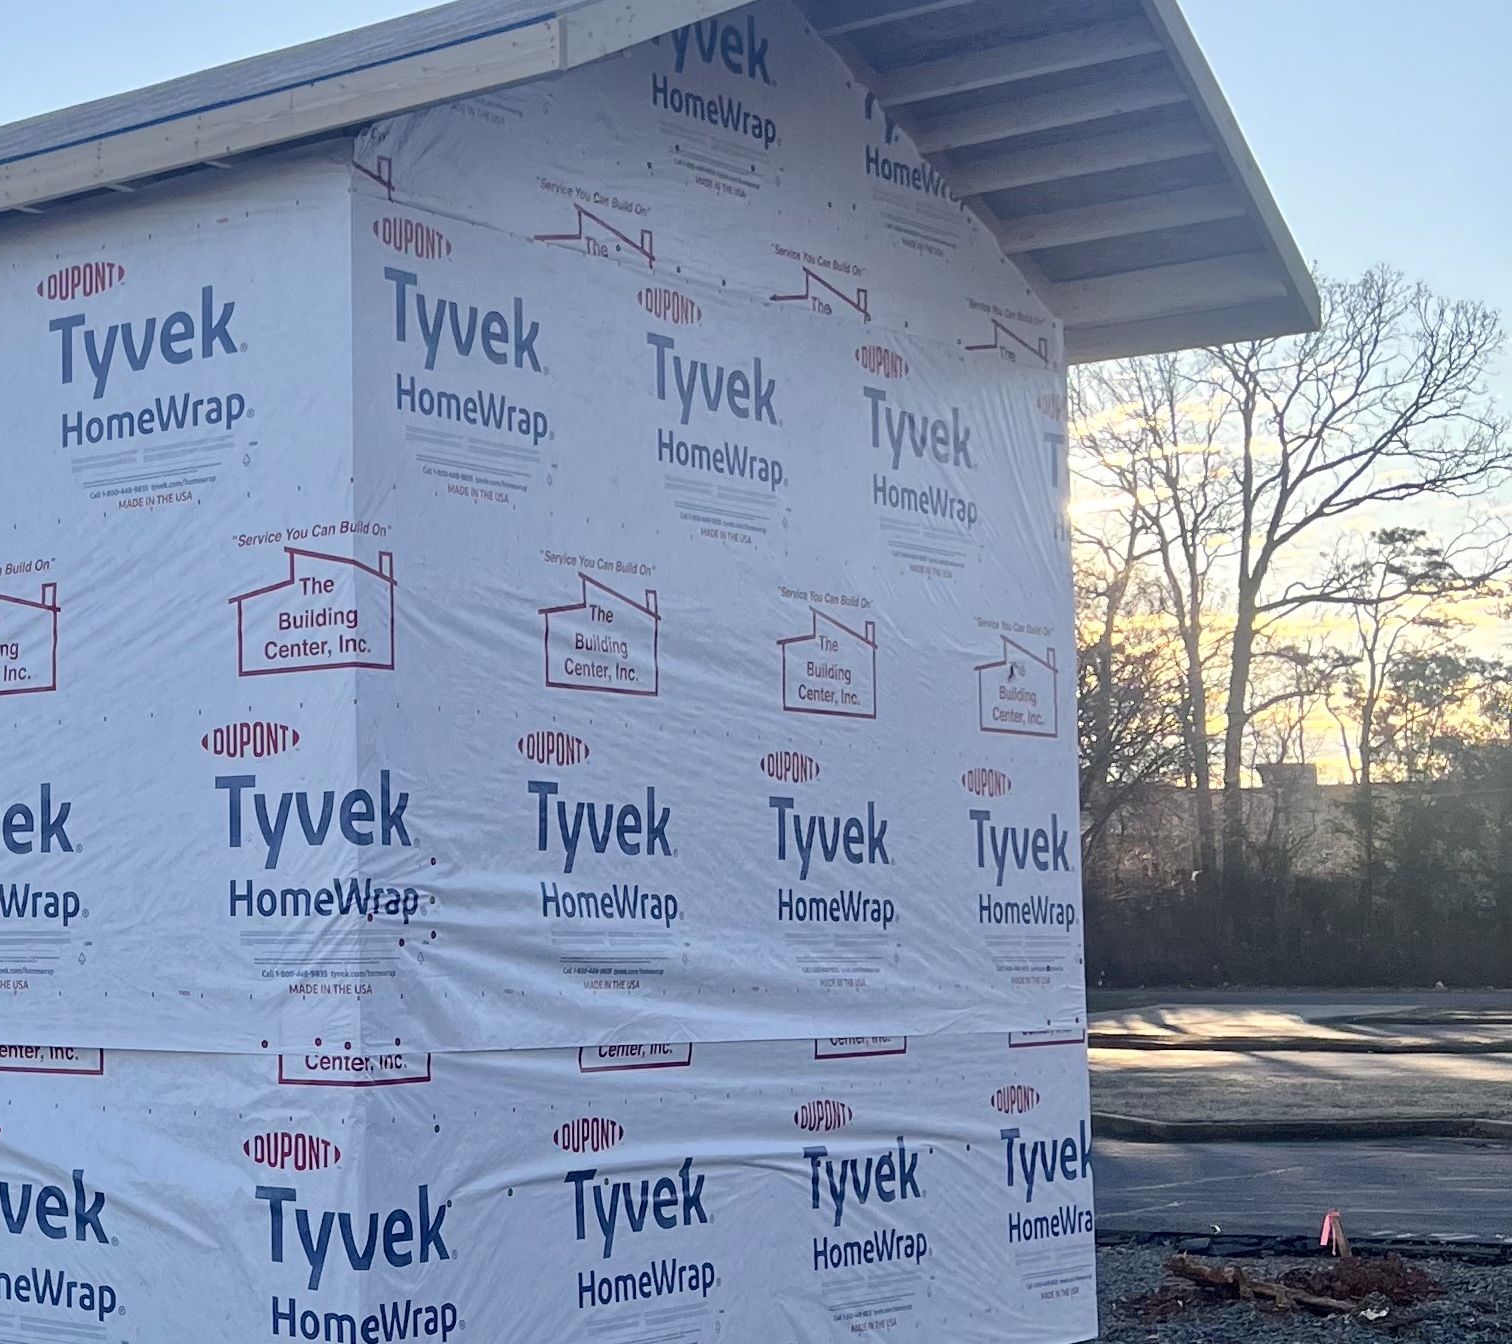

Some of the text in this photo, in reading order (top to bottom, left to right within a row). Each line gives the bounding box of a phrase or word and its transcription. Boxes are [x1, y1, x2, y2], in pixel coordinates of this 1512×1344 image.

[671, 15, 771, 84] yvek
[652, 73, 776, 149] HomeWrap
[383, 218, 444, 259] DUPONT
[47, 262, 116, 300] DUPONT
[384, 266, 541, 372] Tyvek
[645, 288, 696, 324] DUPONT
[49, 285, 238, 400] Tyvek
[646, 332, 777, 425] Tyvek
[62, 393, 244, 448] HomeWrap
[396, 373, 547, 445] HomeWrap
[864, 386, 972, 470] Tyvek
[658, 428, 783, 491] HomeWrap
[119, 491, 192, 509] MADE IN THE USA
[874, 474, 977, 530] HomeWrap
[233, 521, 391, 547] "Service You Can Build On"
[5, 560, 32, 575] Build
[35, 557, 56, 571] On"
[299, 577, 334, 594] The
[279, 607, 358, 631] Building
[589, 605, 614, 623] The
[264, 635, 371, 660] Center, Inc.
[575, 634, 627, 657] Building
[819, 636, 838, 652] The
[3, 665, 31, 681] Inc.
[564, 658, 638, 682] Center, Inc.
[807, 662, 851, 685] Building
[213, 722, 288, 758] DUPONT
[527, 731, 582, 766] DUPONT
[767, 752, 813, 783] DUPONT
[215, 769, 412, 869] Tyvek
[528, 781, 672, 874] Tyvek
[769, 797, 889, 880] Tyvek
[970, 809, 1069, 886] Tyvek
[229, 878, 418, 925] HomeWrap
[542, 881, 677, 928] HomeWrap
[778, 889, 894, 929] HomeWrap
[979, 894, 1074, 932] HomeWrap
[13, 980, 28, 989] USA
[289, 984, 372, 994] MADE IN THE USA
[801, 1100, 846, 1131] DUPONT
[996, 1085, 1034, 1114] DUPONT
[254, 1133, 330, 1170] DUPONT
[562, 1118, 617, 1152] DUPONT
[803, 1136, 921, 1227] Tyvek
[564, 1157, 707, 1259] Tyvek
[1009, 1205, 1092, 1243] HomeWra
[255, 1184, 451, 1290] Tyvek
[814, 1229, 927, 1271] HomeWrap
[578, 1258, 714, 1308] HomeWrap
[272, 1296, 456, 1344] HomeWrap
